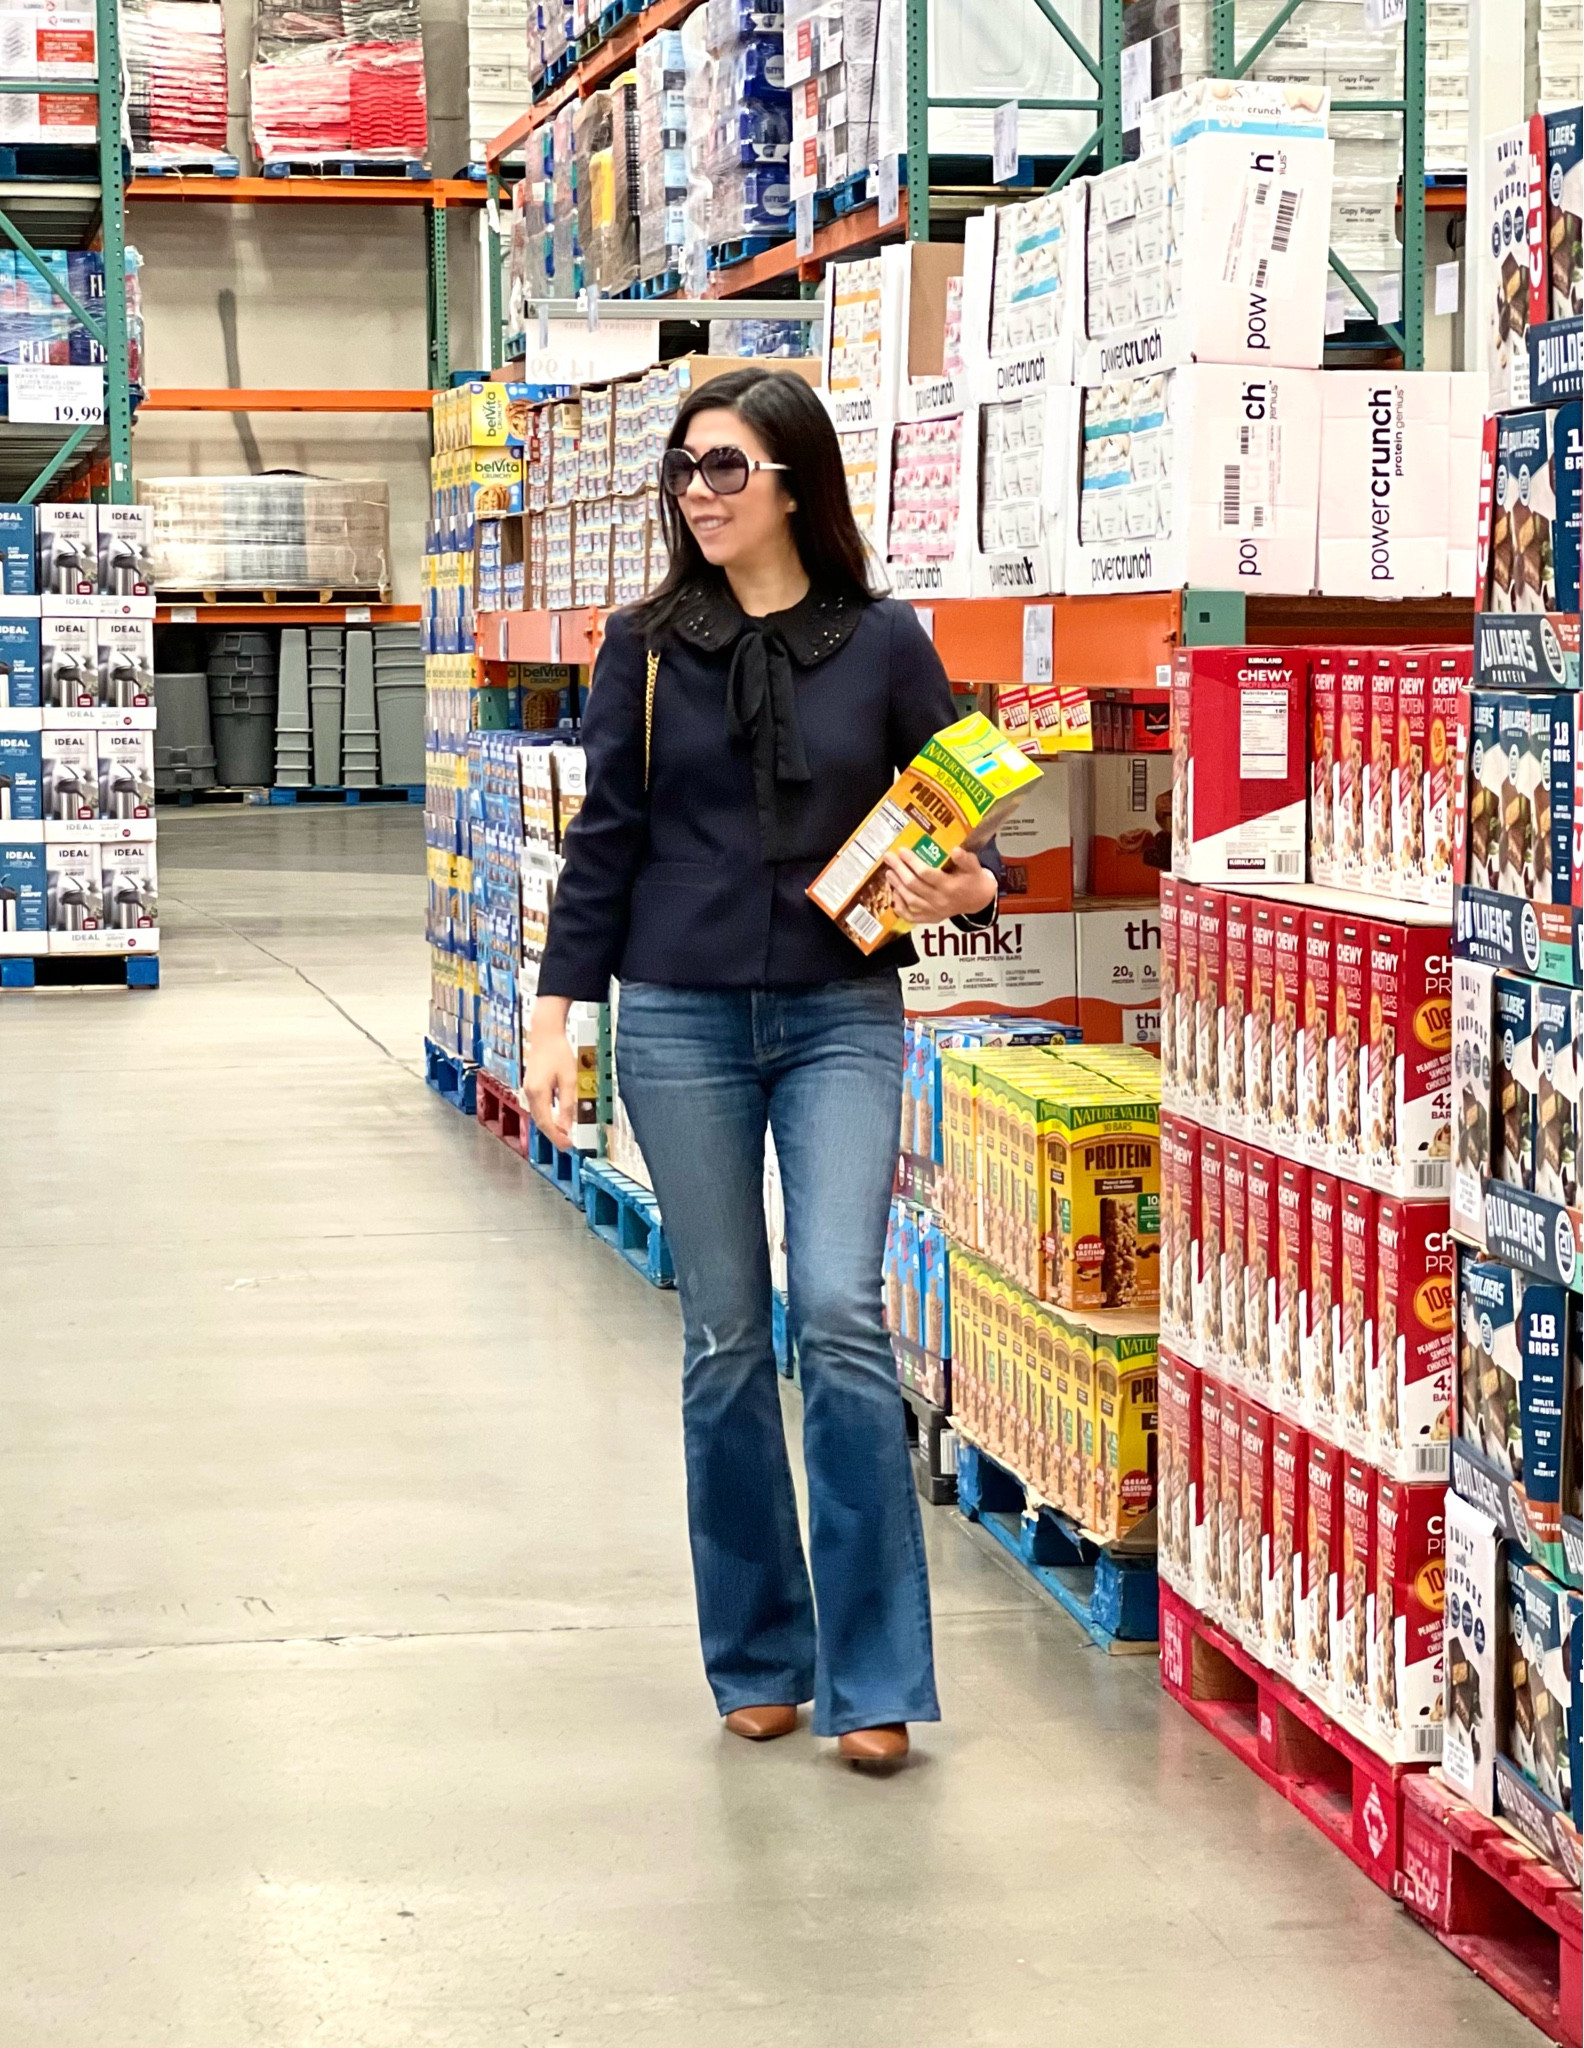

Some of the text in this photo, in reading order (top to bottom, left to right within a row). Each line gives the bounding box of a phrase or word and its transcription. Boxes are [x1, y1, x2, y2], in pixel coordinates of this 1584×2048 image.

[1338, 75, 1380, 83] Copy Paper
[1340, 208, 1358, 216] Copy
[1529, 152, 1543, 290] CLIF
[19, 339, 51, 363] FIJI
[54, 406, 102, 421] 19.99
[486, 391, 496, 437] belVita
[1395, 389, 1404, 477] protein genius
[475, 458, 519, 473] belVita
[1368, 387, 1394, 580] powercrunch
[54, 512, 84, 520] IDEAL
[1477, 451, 1492, 576] CLIF
[523, 666, 568, 678] belVita
[1238, 670, 1292, 682] CHEWY
[1492, 669, 1526, 684] PROTEIN
[1315, 674, 1335, 690] CHEWY
[1342, 674, 1364, 692] CHEWY
[1372, 676, 1395, 693] CHEWY
[1400, 677, 1425, 695] CHEWY
[1432, 676, 1464, 695] CHEWY
[1006, 714, 1028, 731] Jim
[1036, 714, 1058, 731] Jim
[1066, 714, 1090, 730] Jim
[54, 738, 84, 746] IDEAL
[1554, 721, 1568, 746] 18
[0, 739, 30, 747] IDEAL
[1552, 749, 1570, 762] BARS
[924, 742, 991, 807] NATURE VALLEY
[934, 768, 964, 800] 30 BARS
[1454, 723, 1467, 848] CLIF
[910, 781, 956, 828] PROTEIN
[6, 852, 36, 860] IDEAL
[1457, 899, 1514, 954] BUILDERS
[921, 924, 1022, 958] think!
[1252, 926, 1274, 946] CHEWY
[1276, 931, 1298, 952] CHEWY
[1306, 937, 1330, 958] CHEWY
[1336, 944, 1362, 966] CHEWY
[1371, 950, 1398, 972] CHEWY
[909, 972, 954, 984] 20g 0g
[1113, 965, 1156, 978] 20g 0g
[1053, 1036, 1064, 1045] 36
[1416, 1056, 1441, 1074] PEANUT
[1073, 1105, 1160, 1127] NATURE VALLEY
[1432, 1112, 1451, 1120] BAR
[1103, 1123, 1132, 1132] 30 BARS
[1084, 1144, 1152, 1171] PROTEIN
[1486, 1193, 1546, 1262] BUILDERS
[1078, 1242, 1102, 1250] GREAT
[1502, 1240, 1533, 1267] PROTEIN
[1468, 1272, 1505, 1306] BUILDERS
[1530, 1313, 1556, 1340] 18
[1417, 1338, 1440, 1356] PEANUT
[1528, 1340, 1560, 1357] BARS
[1273, 1445, 1296, 1472] CHEWY
[1124, 1478, 1149, 1486] GREAT
[1308, 1462, 1332, 1492] CHEWY
[1344, 1480, 1369, 1510] CHEWY
[1452, 1450, 1507, 1528] BUILDERS
[1418, 1620, 1440, 1636] PEANUT
